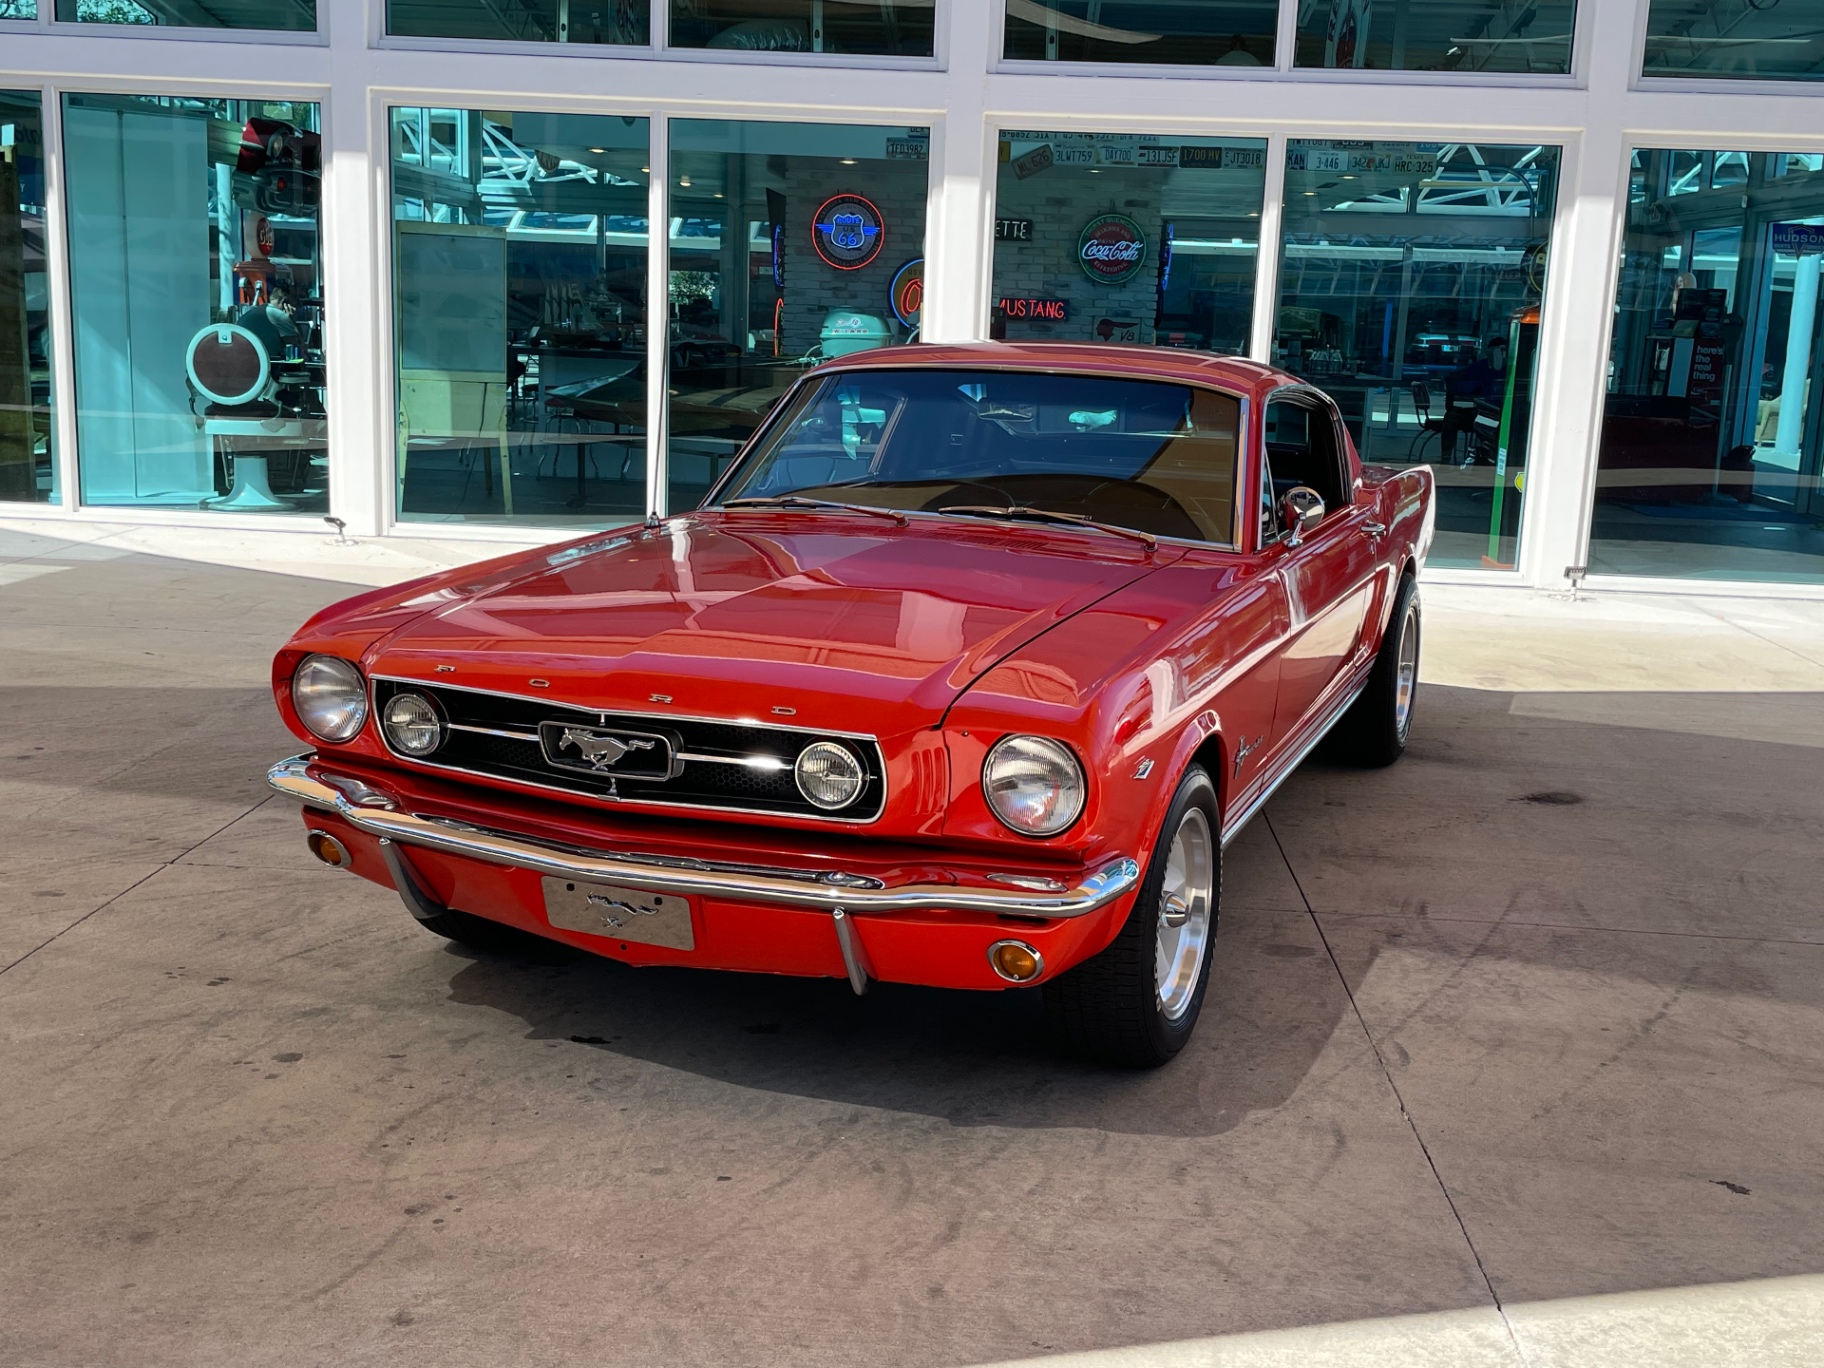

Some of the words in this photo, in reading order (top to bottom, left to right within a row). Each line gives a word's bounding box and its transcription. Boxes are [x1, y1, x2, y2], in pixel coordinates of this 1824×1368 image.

[1030, 150, 1050, 167] 626
[1055, 150, 1092, 162] 3LWT759
[1183, 149, 1206, 161] 1700
[836, 216, 861, 225] ROUTE
[1085, 219, 1105, 237] THIRST
[838, 231, 858, 246] 66
[1081, 239, 1144, 261] Coca-Cola
[1120, 329, 1136, 342] V8
[1695, 355, 1711, 363] the
[1694, 363, 1712, 371] real
[1693, 371, 1716, 383] thing
